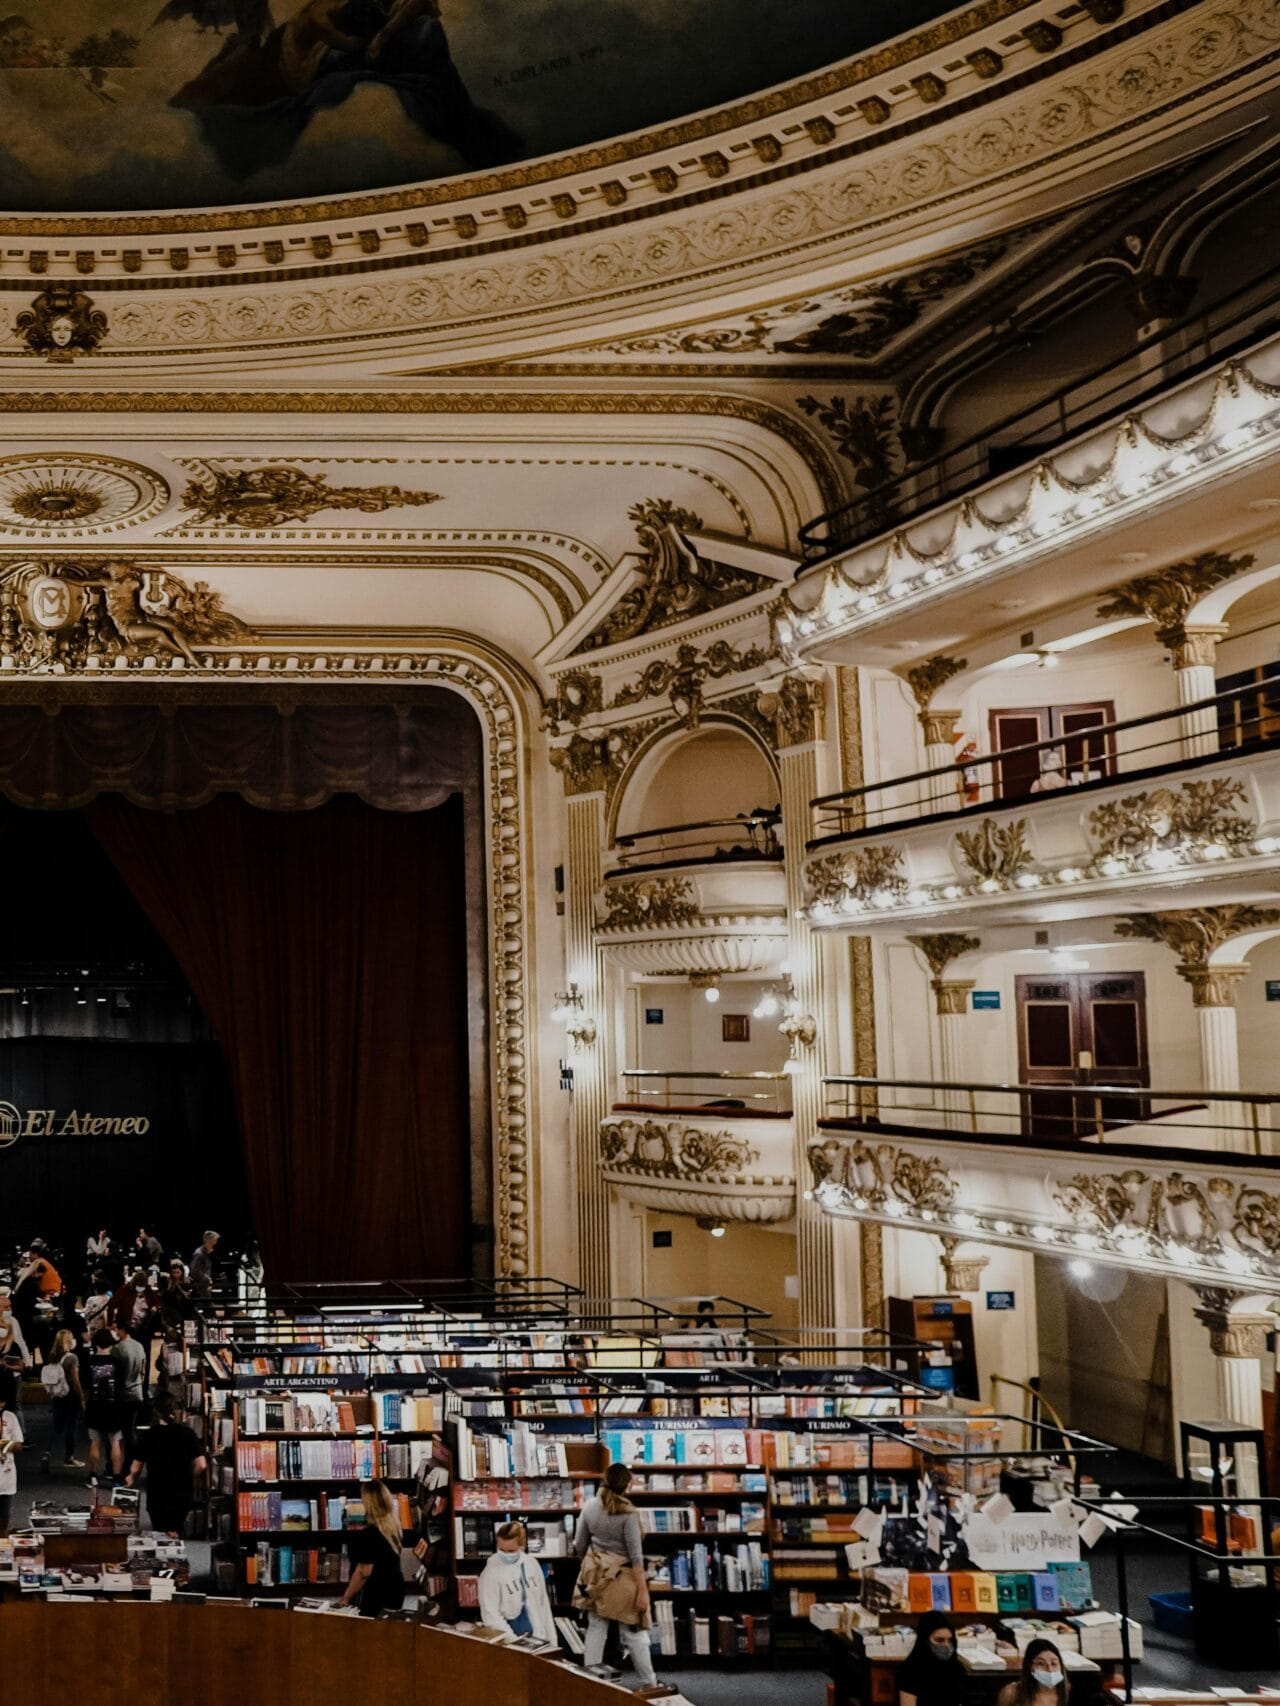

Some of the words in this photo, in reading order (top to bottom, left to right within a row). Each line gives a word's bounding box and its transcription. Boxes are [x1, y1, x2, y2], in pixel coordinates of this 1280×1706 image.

[21, 1110, 56, 1136] El
[57, 1109, 150, 1135] Ateneo
[263, 1378, 286, 1386] ARTE
[287, 1377, 339, 1386] ARGENTINO
[698, 1374, 720, 1383] ARTE
[832, 1374, 855, 1383] ARTE
[652, 1420, 698, 1430] TURISMO
[806, 1421, 851, 1430] TURISMO
[1011, 1530, 1039, 1552] Harry
[1040, 1530, 1073, 1550] Potter
